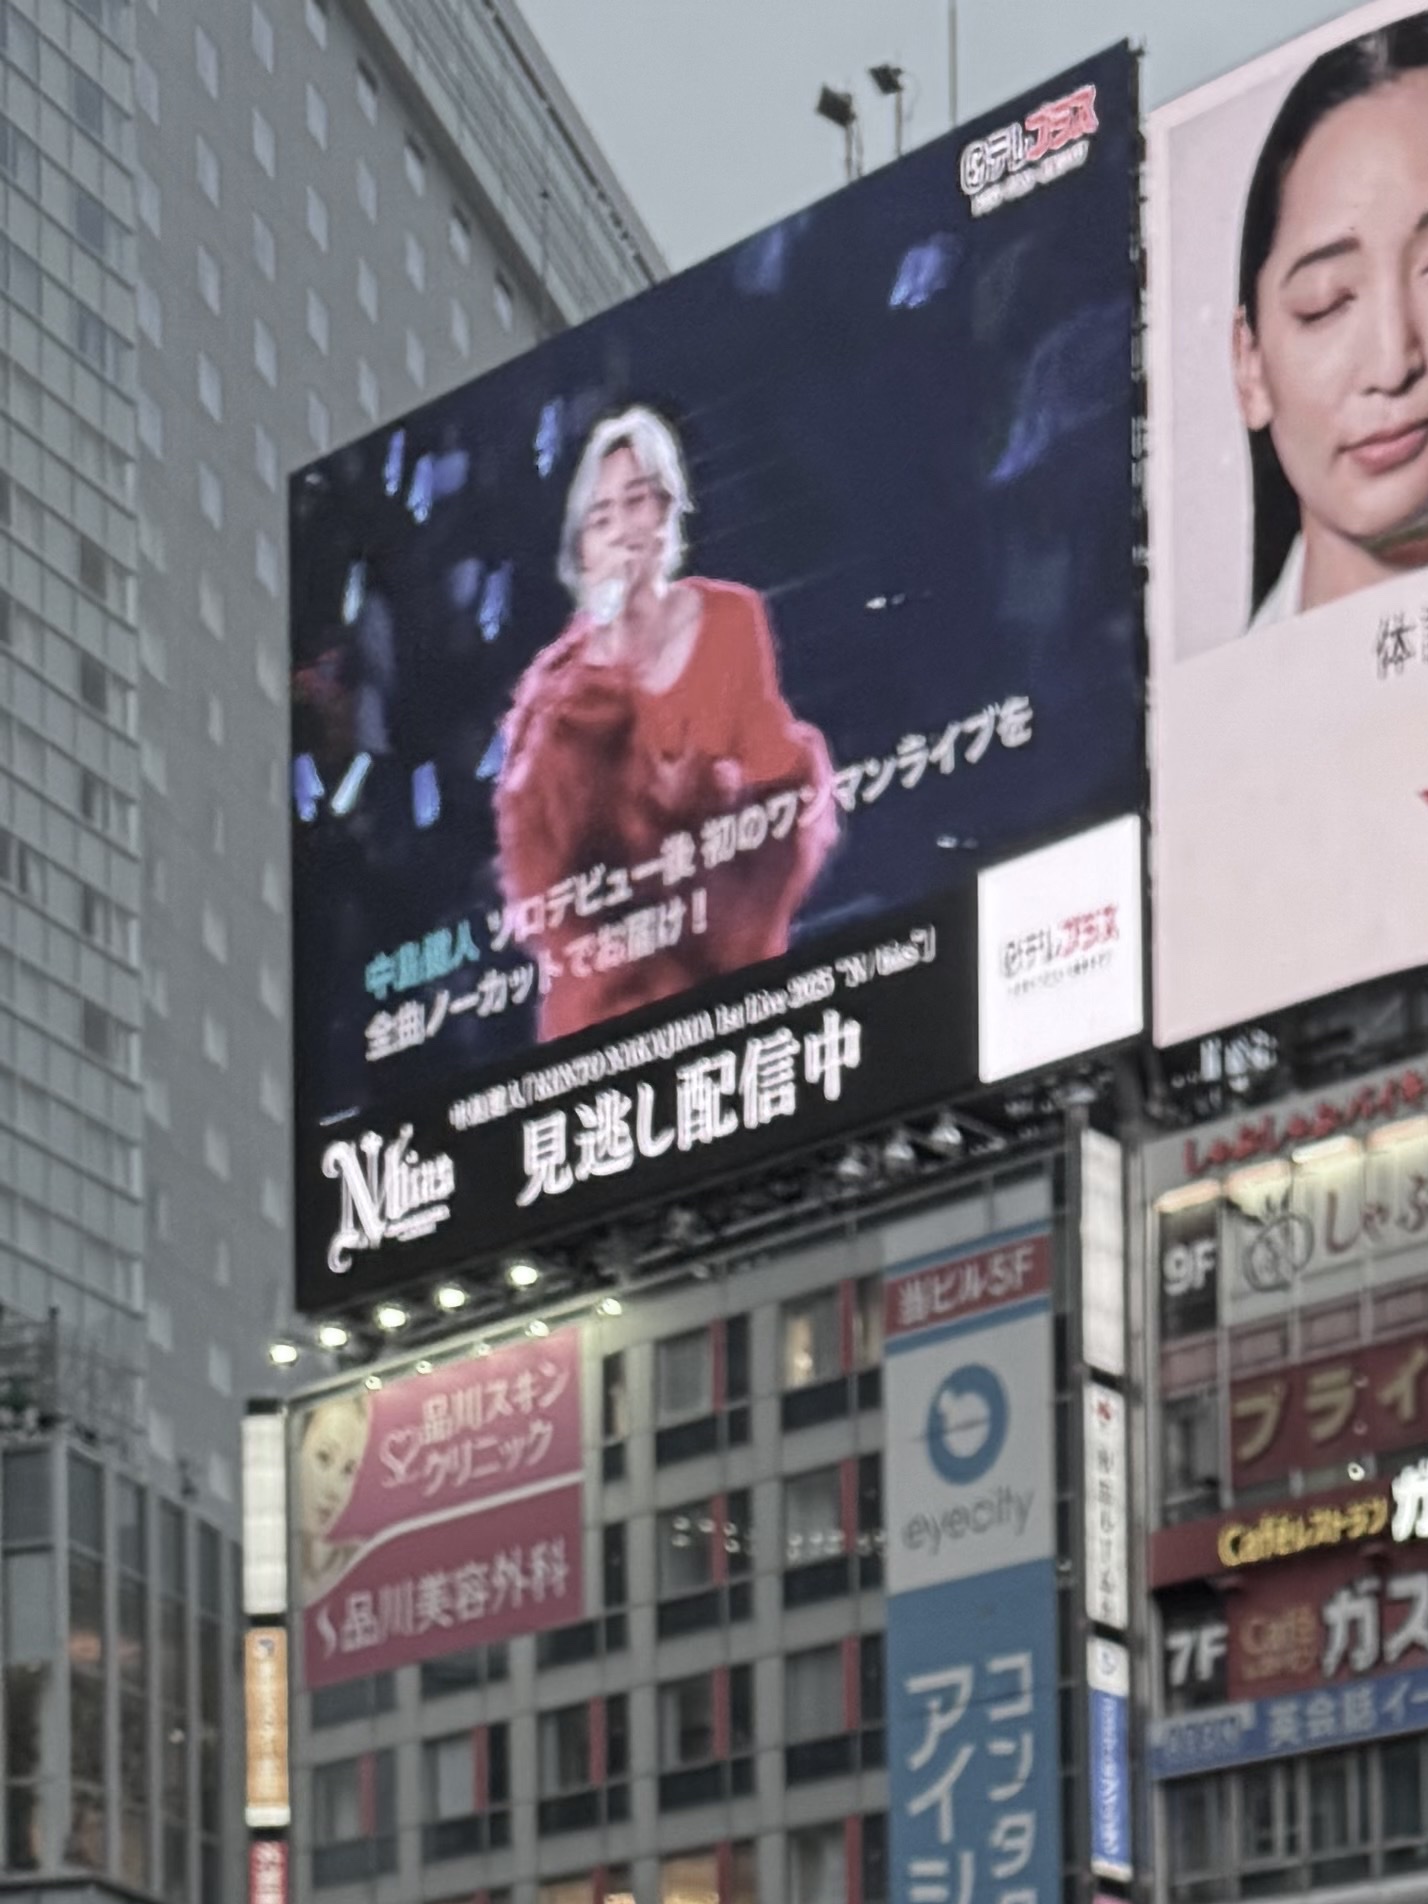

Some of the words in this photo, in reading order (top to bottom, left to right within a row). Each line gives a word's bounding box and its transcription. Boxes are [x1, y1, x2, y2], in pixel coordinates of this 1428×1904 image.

[516, 1009, 862, 1206] 見逃し配信中
[1163, 1240, 1215, 1297] 9F
[423, 1418, 554, 1497] クリニック
[902, 1484, 1035, 1556] eyecity
[341, 1535, 571, 1654] 品川美容外科
[1166, 1624, 1229, 1687] 7F
